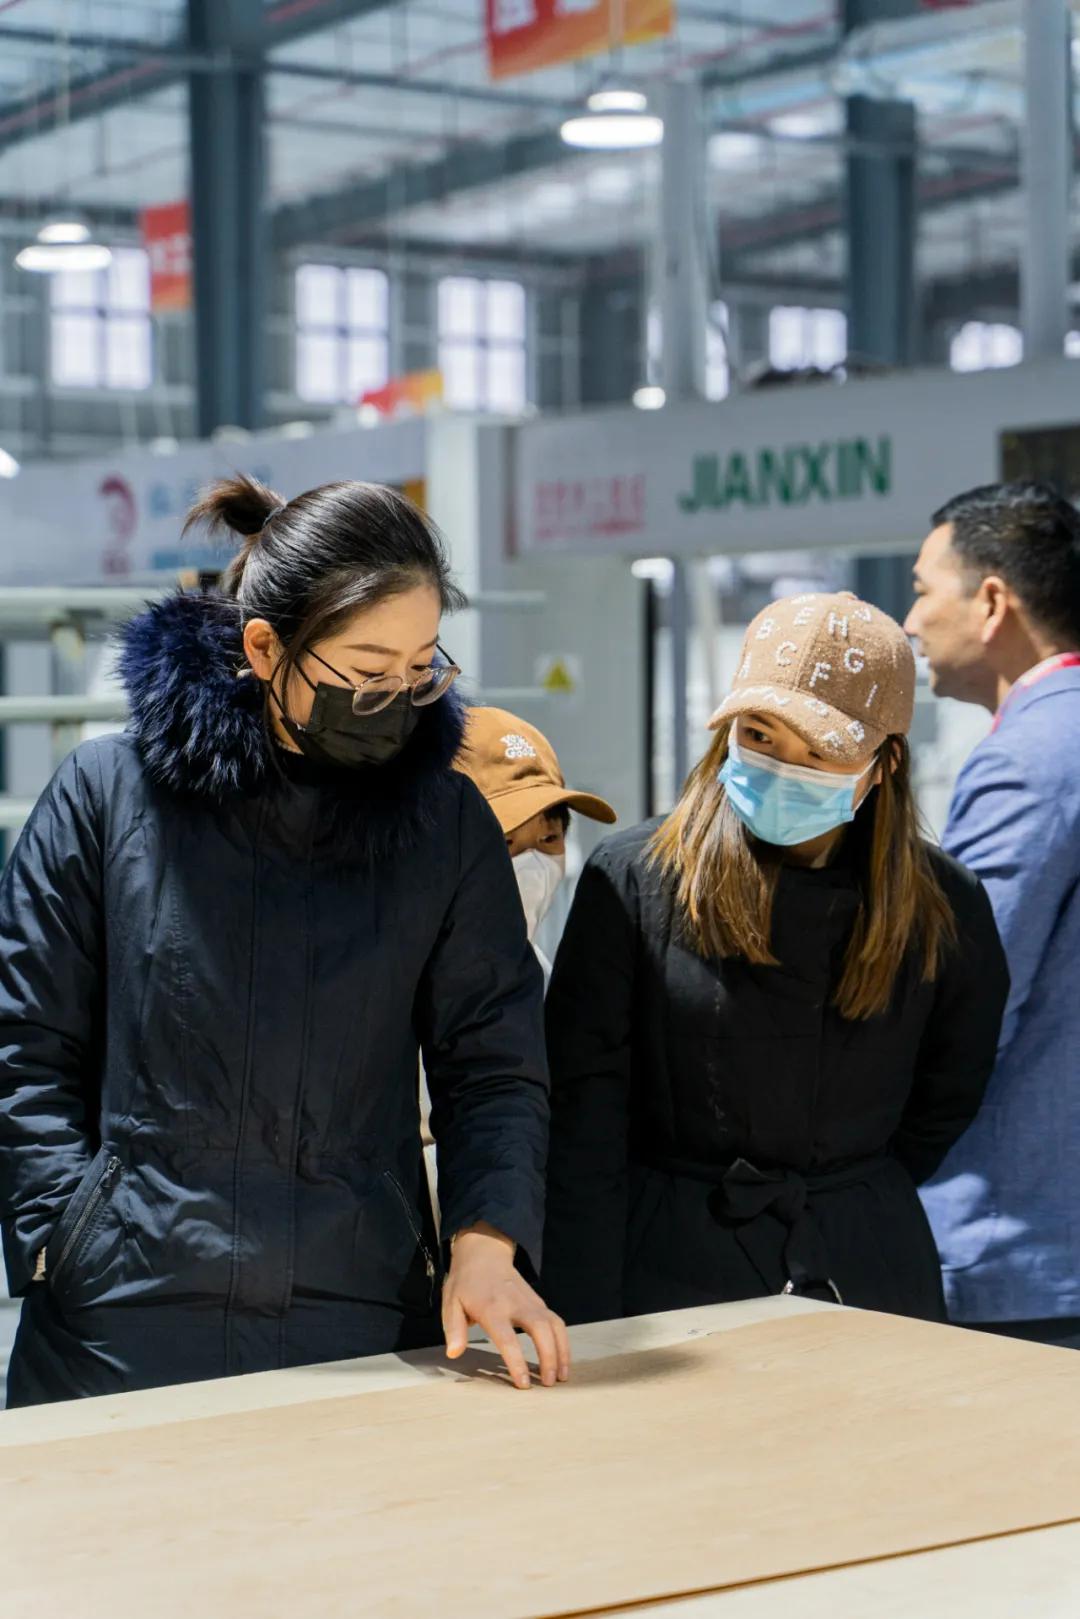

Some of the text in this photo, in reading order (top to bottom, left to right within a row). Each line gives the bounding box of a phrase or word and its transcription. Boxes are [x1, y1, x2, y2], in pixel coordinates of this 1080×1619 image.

[679, 434, 891, 513] JIANXIN
[827, 612, 848, 637] H
[776, 641, 797, 666] C
[843, 647, 865, 673] G
[809, 661, 832, 687] F
